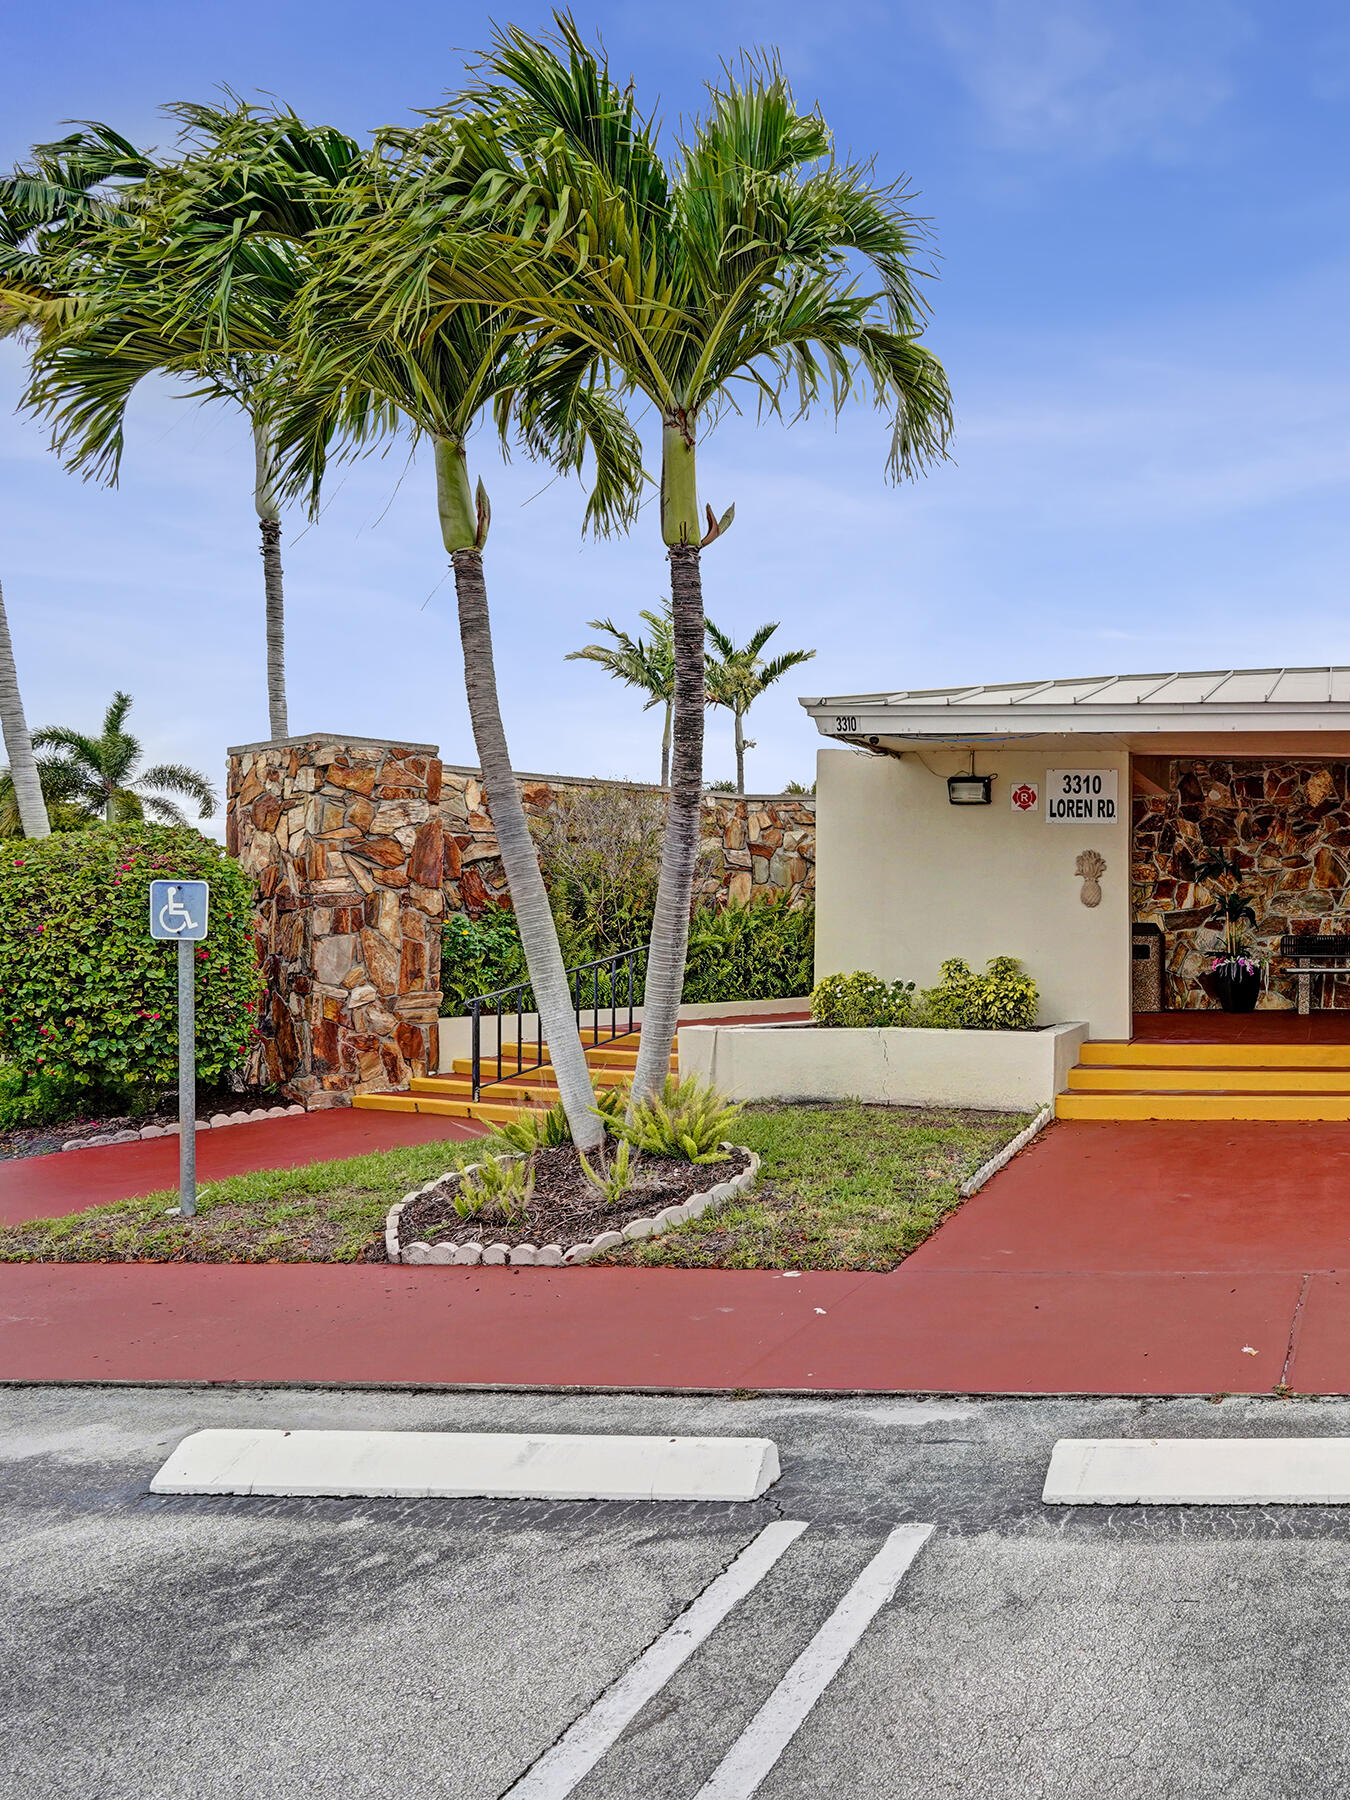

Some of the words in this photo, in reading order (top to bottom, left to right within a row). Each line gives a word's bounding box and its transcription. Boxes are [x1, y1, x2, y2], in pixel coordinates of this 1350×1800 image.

[836, 716, 857, 732] 3310
[1062, 775, 1102, 794] 3310
[1021, 793, 1028, 802] R
[1049, 798, 1093, 818] LOREN
